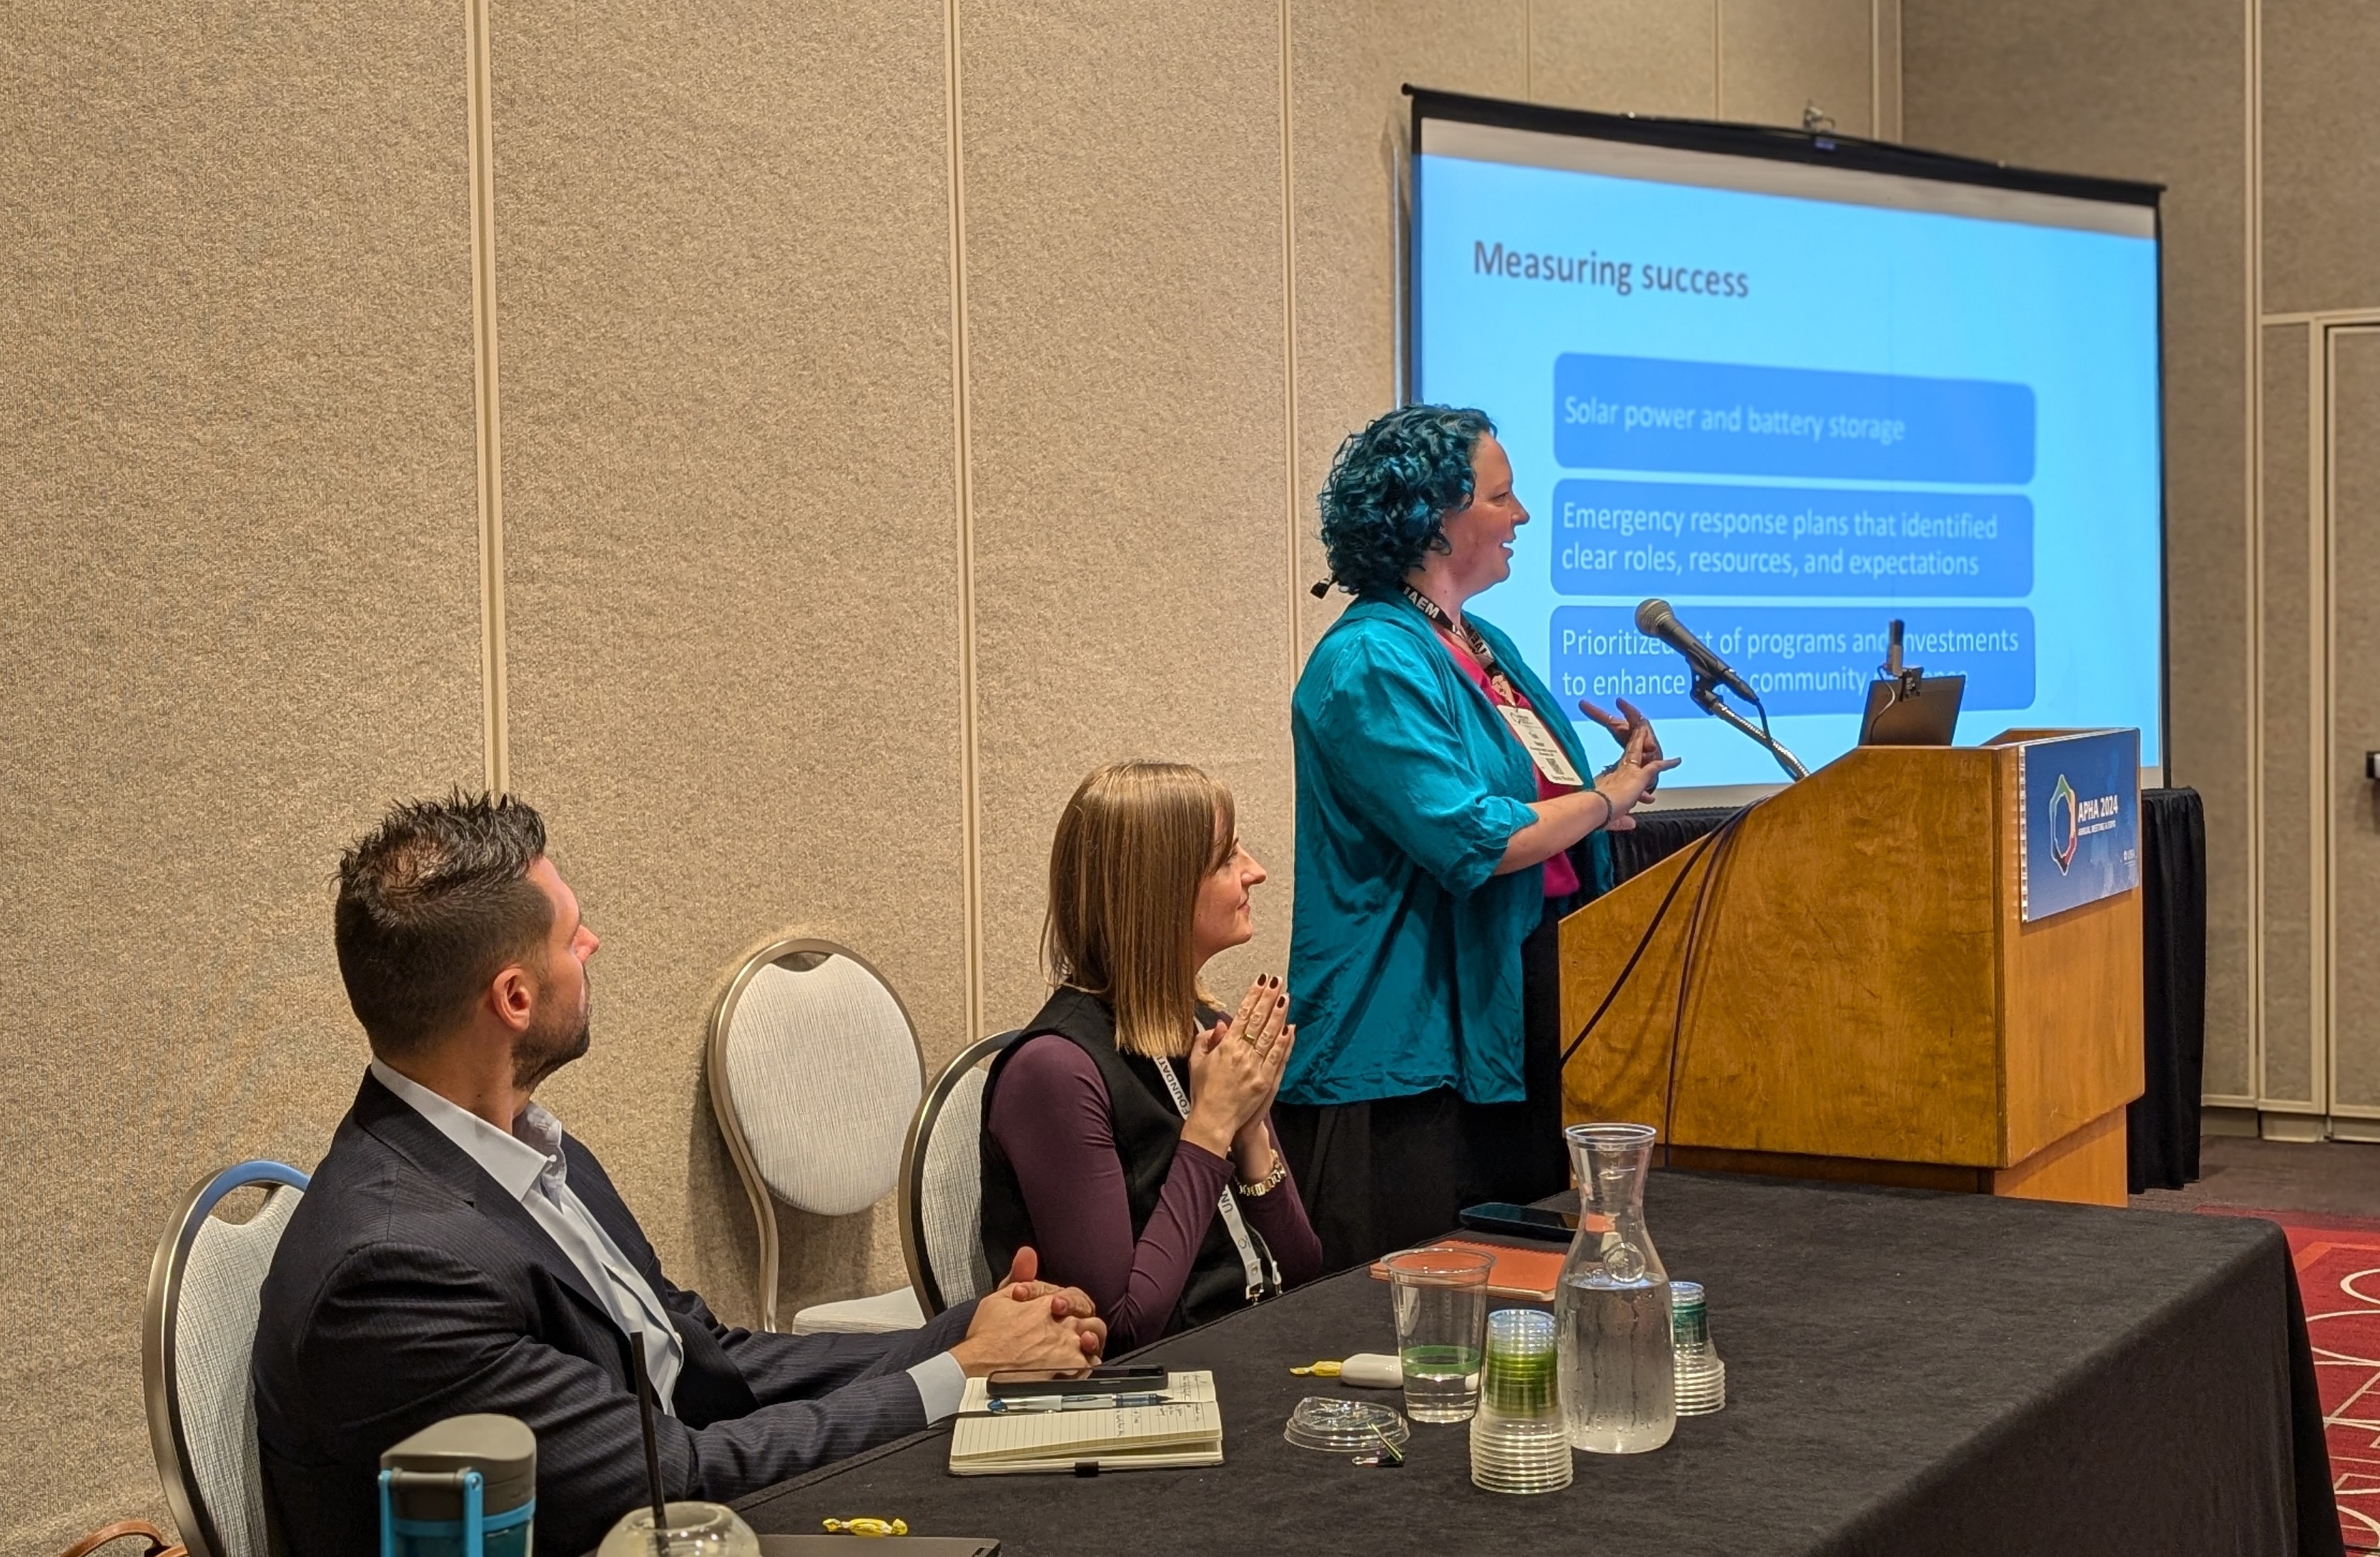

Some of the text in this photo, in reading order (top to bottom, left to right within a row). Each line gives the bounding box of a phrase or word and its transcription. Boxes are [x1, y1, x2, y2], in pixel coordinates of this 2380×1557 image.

[1474, 240, 1749, 297] Measuring success
[1565, 395, 1905, 445] Solar power and battery storage
[1564, 501, 1998, 542] Emergency response plans that identified
[1562, 542, 1979, 579] clear roles, resources, and expectations
[1403, 586, 1440, 619] IAEM
[1719, 626, 1742, 653] of
[1748, 631, 1846, 659] programs
[1903, 629, 2019, 653] nvestments
[1562, 672, 1586, 696] to
[1593, 668, 1685, 694] enhance
[1750, 665, 1867, 696] community
[2078, 794, 2118, 823] APHA 2024
[1156, 1055, 1190, 1115] FOUNDATI
